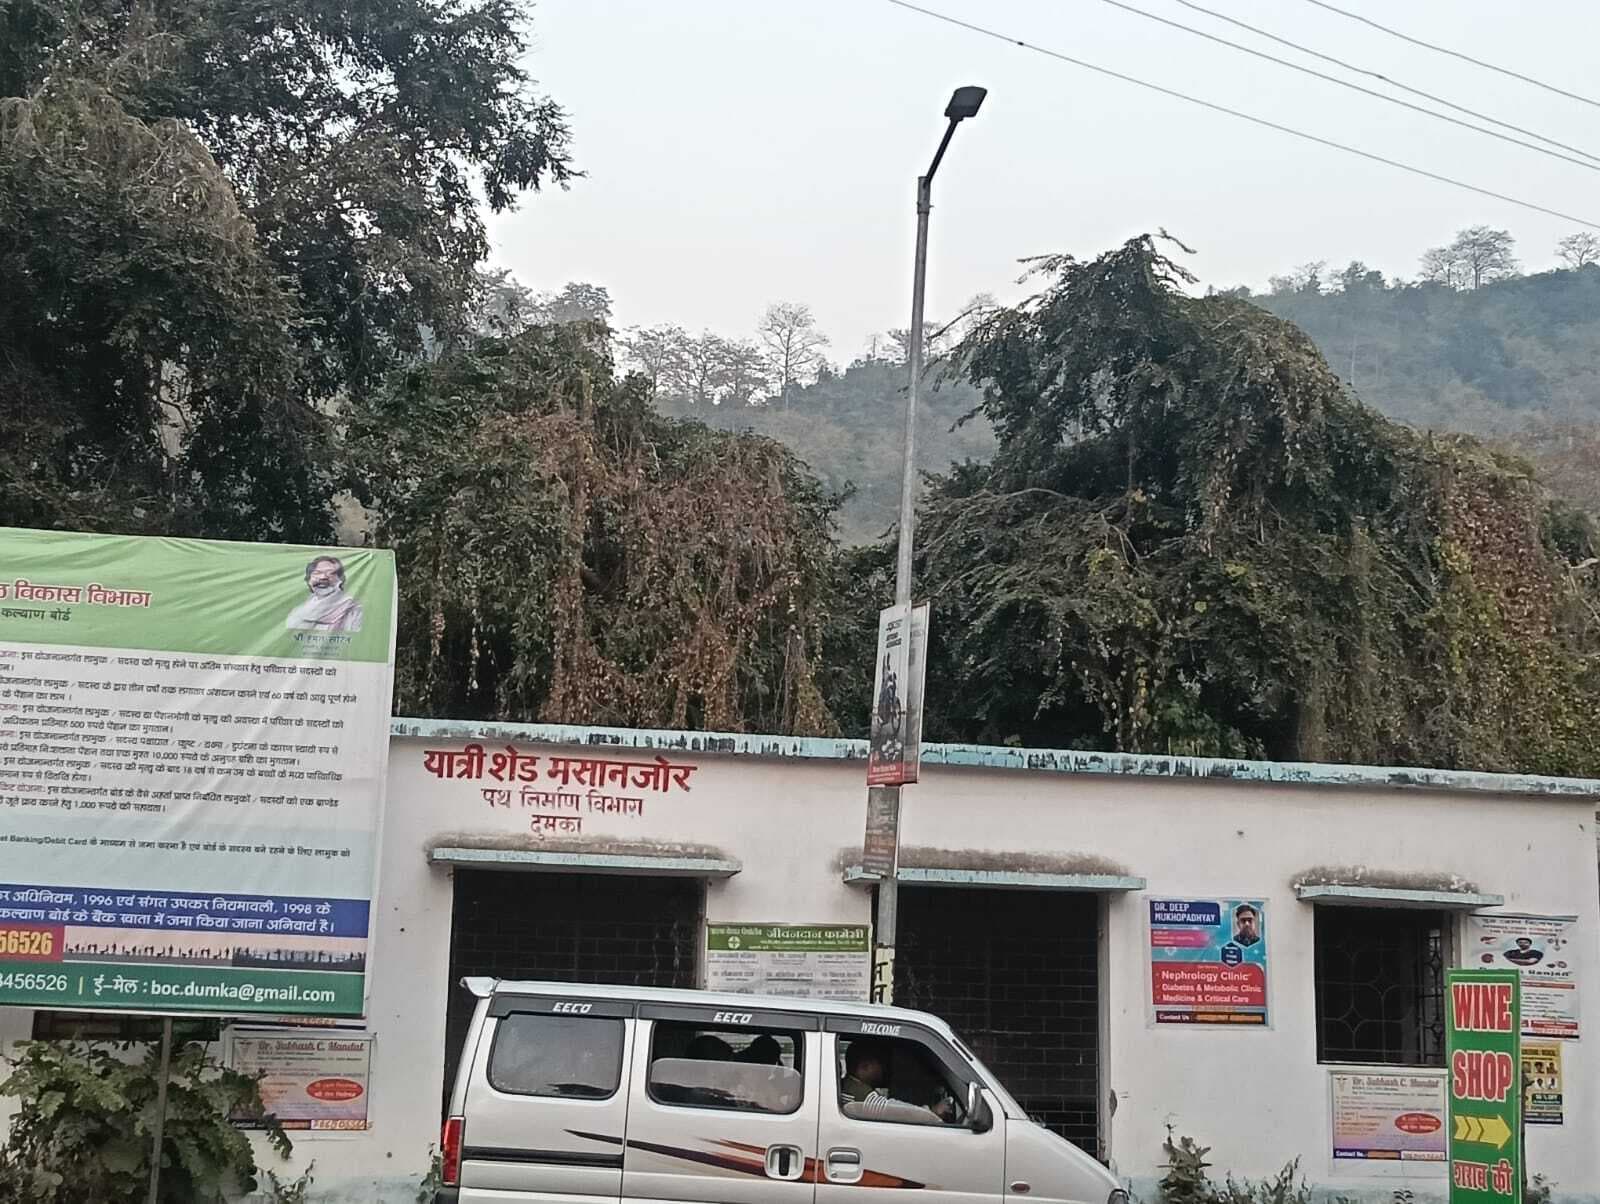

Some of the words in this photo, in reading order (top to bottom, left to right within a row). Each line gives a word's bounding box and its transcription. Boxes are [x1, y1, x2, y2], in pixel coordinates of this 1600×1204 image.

[14, 578, 82, 603] विकास
[88, 583, 152, 607] विभाग
[1, 607, 45, 620] कल्याण
[50, 608, 72, 621] बोर्ड
[152, 752, 178, 760] 10,000
[424, 744, 486, 780] यात्री
[488, 744, 540, 782] शेड
[547, 755, 698, 792] मसानजोर
[75, 801, 96, 809] 1,000
[481, 788, 512, 809] पथ
[520, 785, 580, 812] निर्माण
[588, 788, 644, 816] विभाग
[530, 814, 582, 840] दुमका
[13, 889, 77, 904] अधिनियम,
[83, 894, 113, 906] 1996
[116, 895, 134, 906] एवं
[138, 896, 168, 908] संगत
[171, 898, 208, 910] उपकर
[213, 897, 278, 914] नियमावली,
[284, 903, 312, 914] 1998
[316, 902, 332, 914] के
[1154, 903, 1167, 912] DR.
[1169, 904, 1189, 912] DEEP
[0, 908, 45, 920] कल्याण
[48, 907, 71, 921] बोर्ड
[72, 909, 88, 922] के
[92, 909, 116, 922] बैंक
[120, 912, 151, 925] खाता
[154, 912, 165, 925] में
[167, 915, 193, 927] जमा
[197, 914, 228, 928] किया
[232, 918, 264, 930] जाना
[267, 917, 317, 932] अनिवार्य
[1162, 971, 1218, 982] Nephrology
[1221, 972, 1249, 981] Clinic
[151, 980, 335, 1002] boc.dumka@gmail.com
[1162, 984, 1195, 992] Diabetes
[1204, 984, 1238, 992] Metabolic
[1163, 994, 1195, 1002] Medicine
[552, 1002, 591, 1014] EECO
[1452, 982, 1512, 1032] WINE
[712, 1011, 752, 1024] EECO
[860, 1022, 900, 1036] WELCOME
[258, 1041, 272, 1050] Dr.
[1452, 1049, 1513, 1102] SHOP
[1452, 1160, 1490, 1192] शराब
[1491, 1158, 1514, 1196] की
